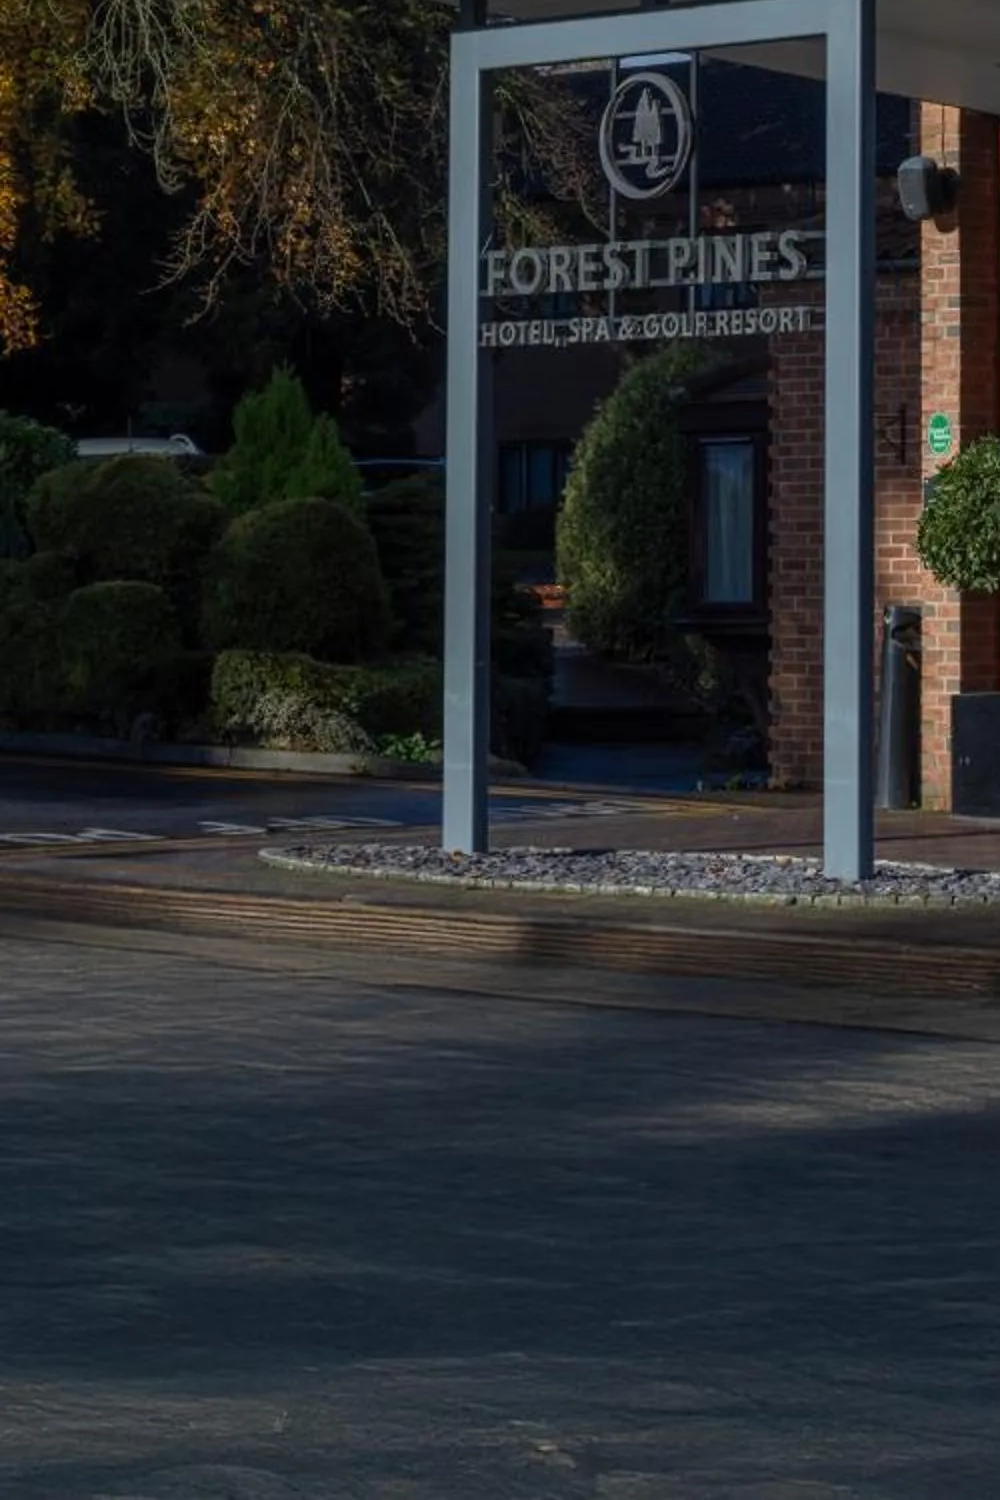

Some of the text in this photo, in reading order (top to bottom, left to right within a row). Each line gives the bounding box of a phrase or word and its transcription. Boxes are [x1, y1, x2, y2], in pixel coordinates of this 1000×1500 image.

[486, 229, 807, 297] FOREST PINES
[567, 315, 612, 342] SPA
[619, 315, 640, 340] &
[642, 311, 707, 338] GOLF
[716, 307, 810, 336] RESORT
